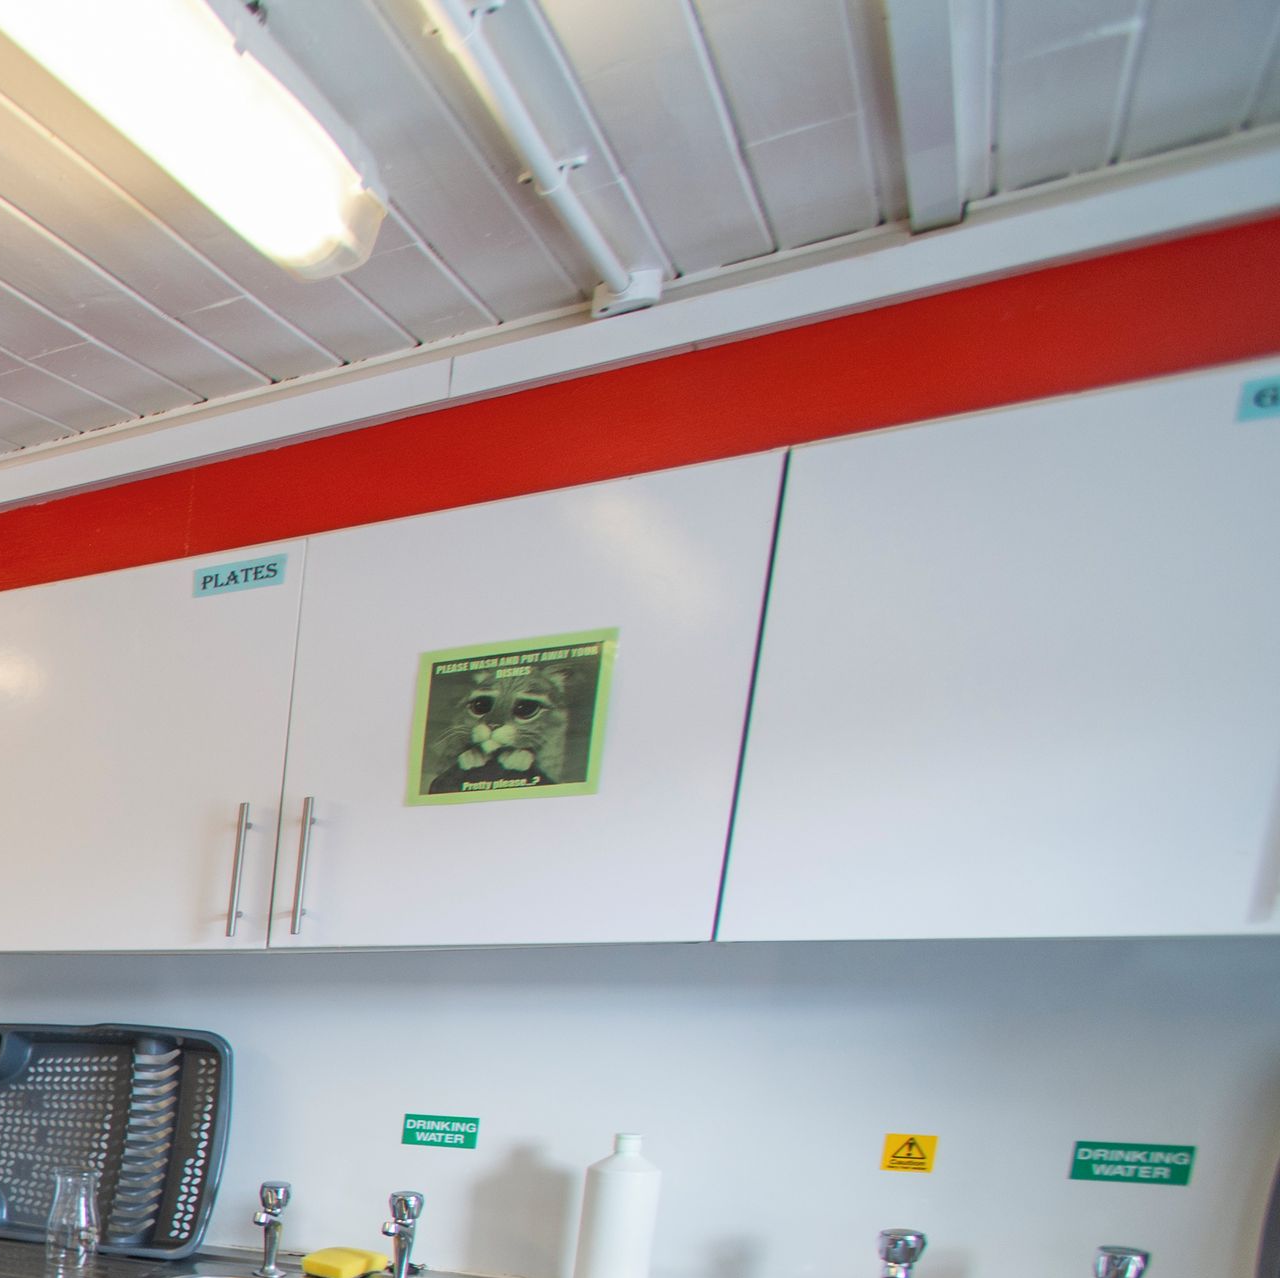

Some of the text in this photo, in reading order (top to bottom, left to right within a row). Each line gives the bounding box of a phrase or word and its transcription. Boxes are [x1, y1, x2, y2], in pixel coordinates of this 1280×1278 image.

[201, 563, 277, 590] PLATES
[436, 645, 599, 674] PLEASE WASH AND PUT AWAY YOUR
[496, 666, 531, 679] DISHES
[462, 780, 492, 792] Pretty
[406, 1119, 477, 1133] DRINKING
[415, 1131, 465, 1144] WATER
[1077, 1147, 1192, 1166] DRINKING
[1091, 1163, 1172, 1179] WATER
